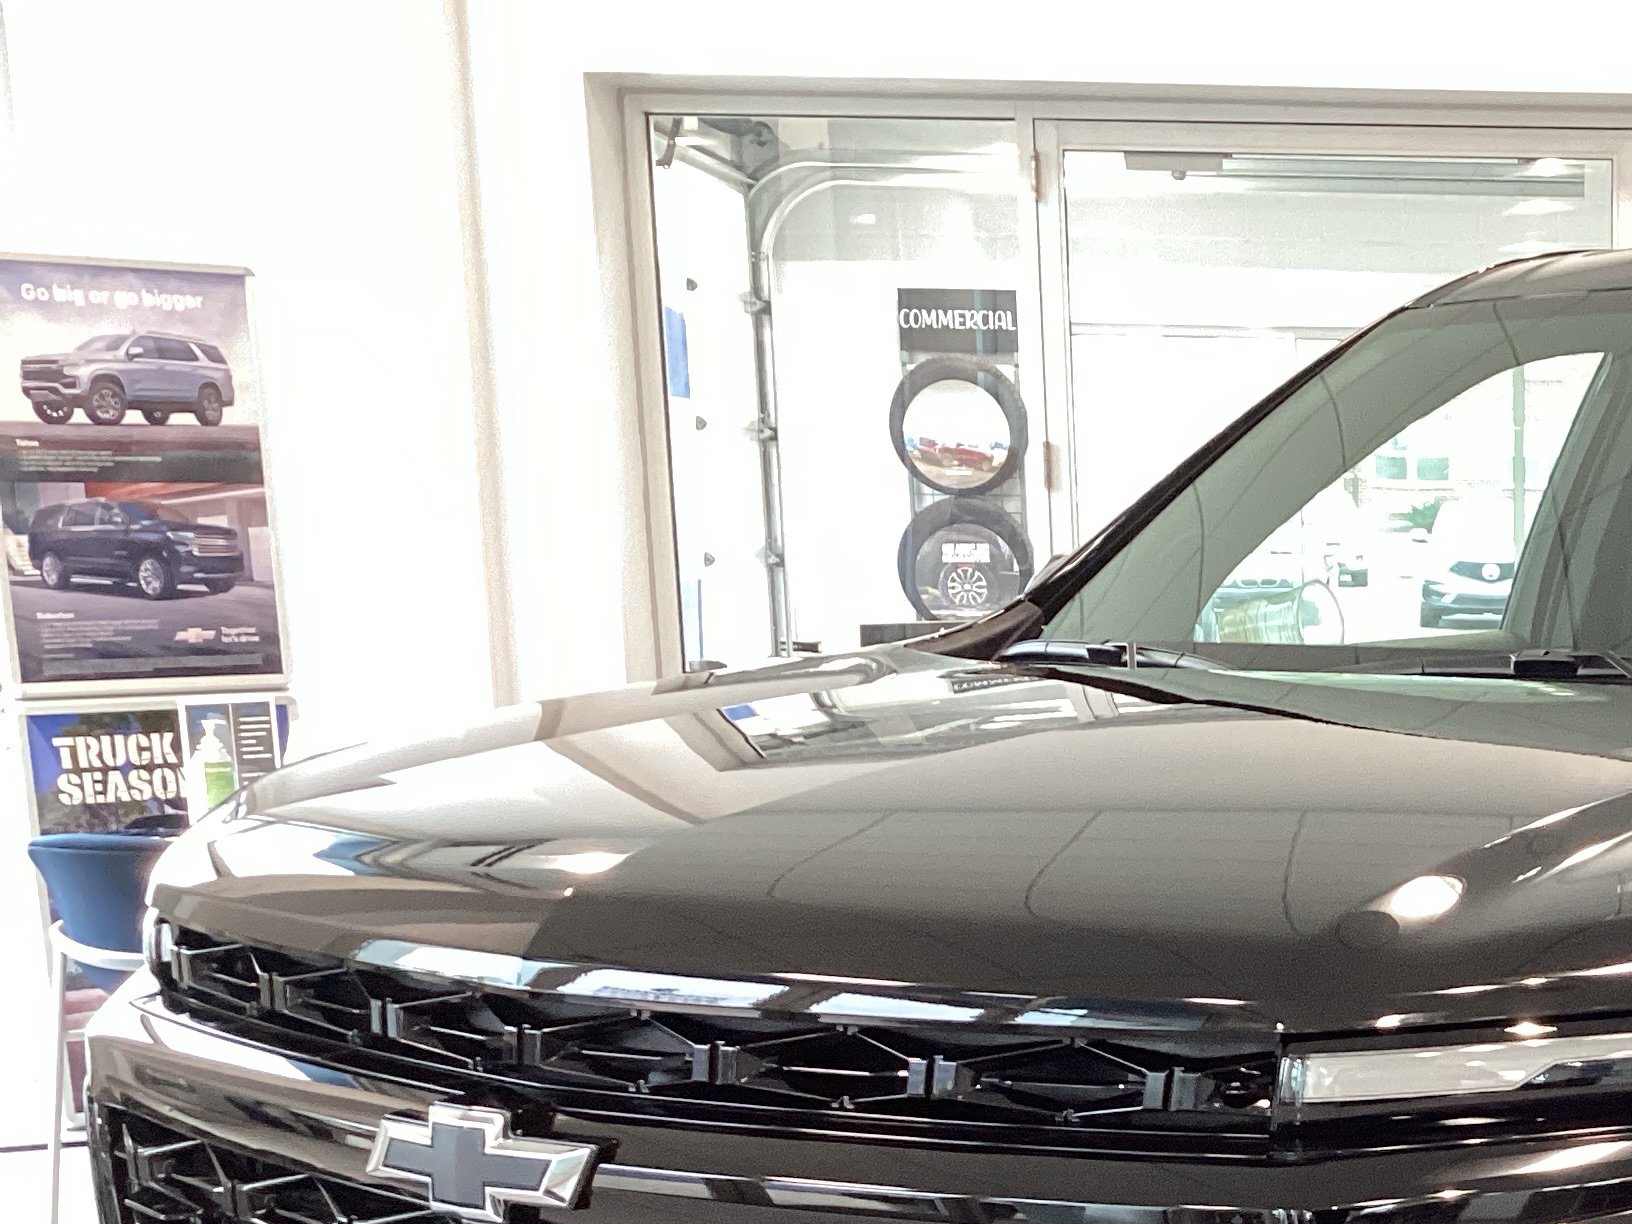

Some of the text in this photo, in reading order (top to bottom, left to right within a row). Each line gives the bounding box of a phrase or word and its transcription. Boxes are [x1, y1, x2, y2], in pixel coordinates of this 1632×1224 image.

[20, 282, 203, 311] Go big or go bigger
[899, 308, 1017, 331] COMMERCIAL
[52, 732, 179, 769] TRUCK
